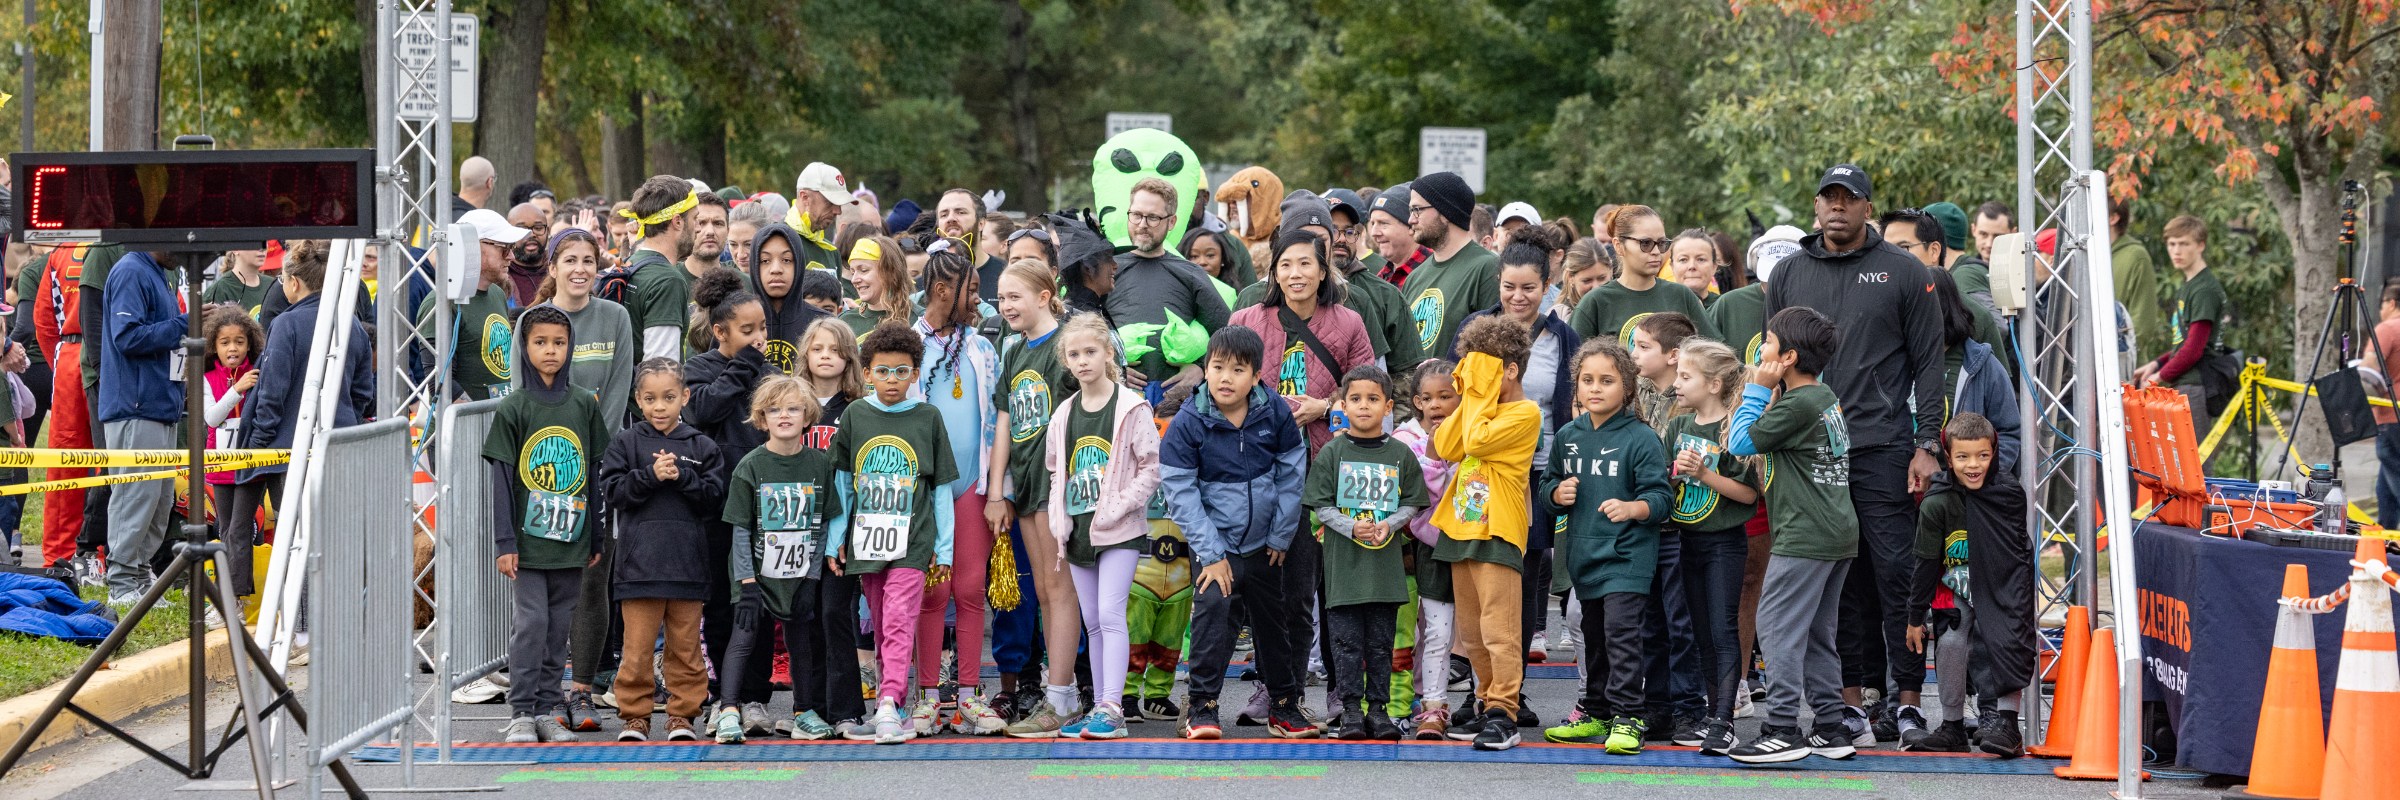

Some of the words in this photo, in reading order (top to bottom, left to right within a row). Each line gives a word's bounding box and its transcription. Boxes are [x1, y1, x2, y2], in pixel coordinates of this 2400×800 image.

[1832, 167, 1853, 176] NIKE
[1011, 394, 1044, 427] 2039
[0, 451, 34, 465] UTION
[61, 451, 109, 465] CAUTION
[134, 451, 182, 464] CAUTION
[206, 451, 253, 463] CAUTION
[529, 436, 579, 472] ZOMBIE
[1563, 457, 1619, 477] NIKE
[555, 456, 580, 492] RUN
[861, 486, 908, 513] 2000
[1343, 475, 1395, 503] 2282
[530, 503, 581, 533] 2107
[767, 496, 812, 522] 2174
[862, 526, 898, 552] 700
[1159, 542, 1174, 556] M
[774, 544, 805, 570] 743
